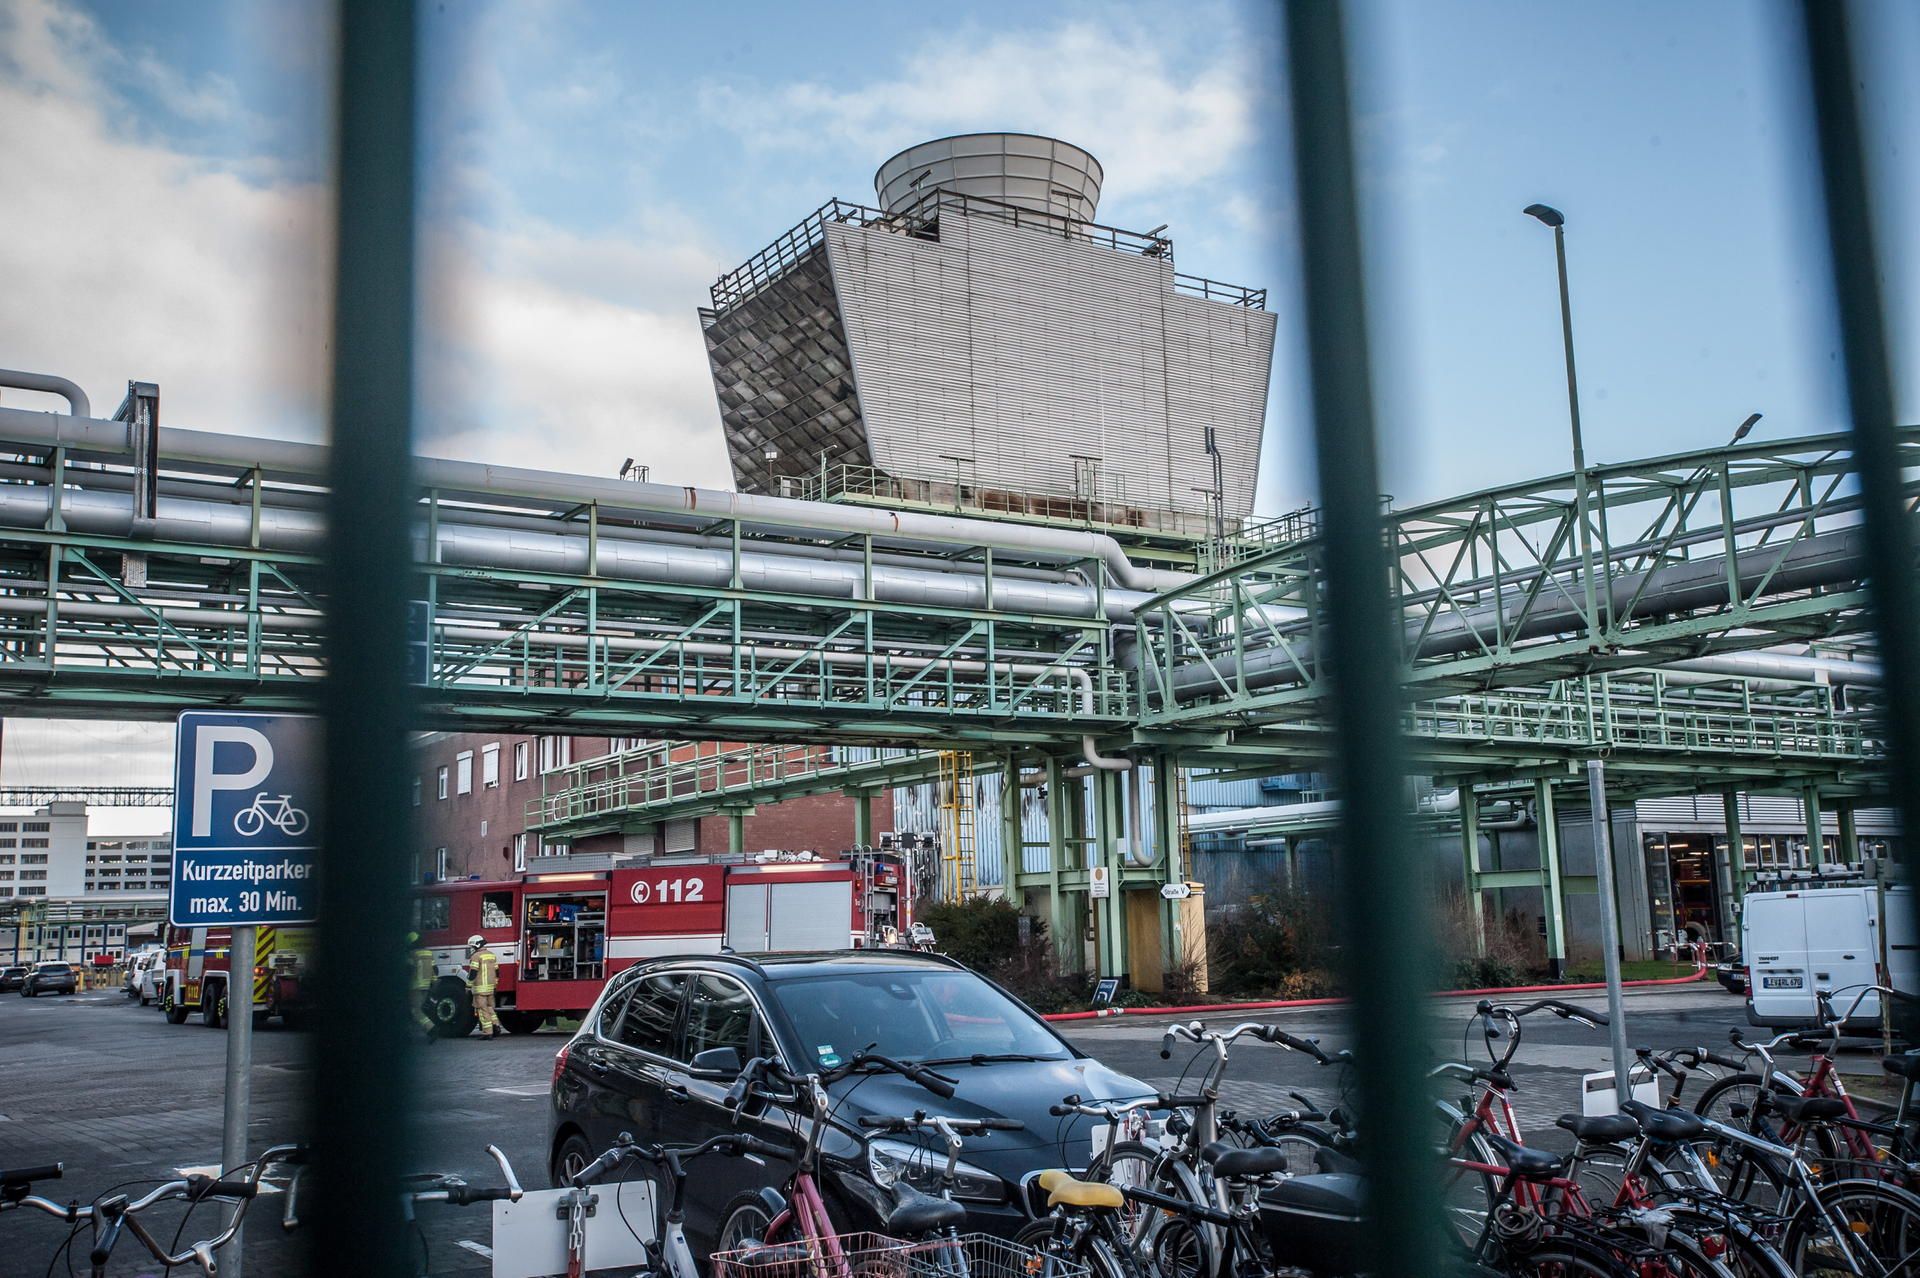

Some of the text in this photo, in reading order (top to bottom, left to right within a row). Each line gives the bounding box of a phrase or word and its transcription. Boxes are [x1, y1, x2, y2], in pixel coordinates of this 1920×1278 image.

[192, 725, 274, 837] P
[182, 859, 312, 885] Kurzzeitparker
[190, 891, 302, 913] max. 30 Min.
[655, 878, 704, 902] 112
